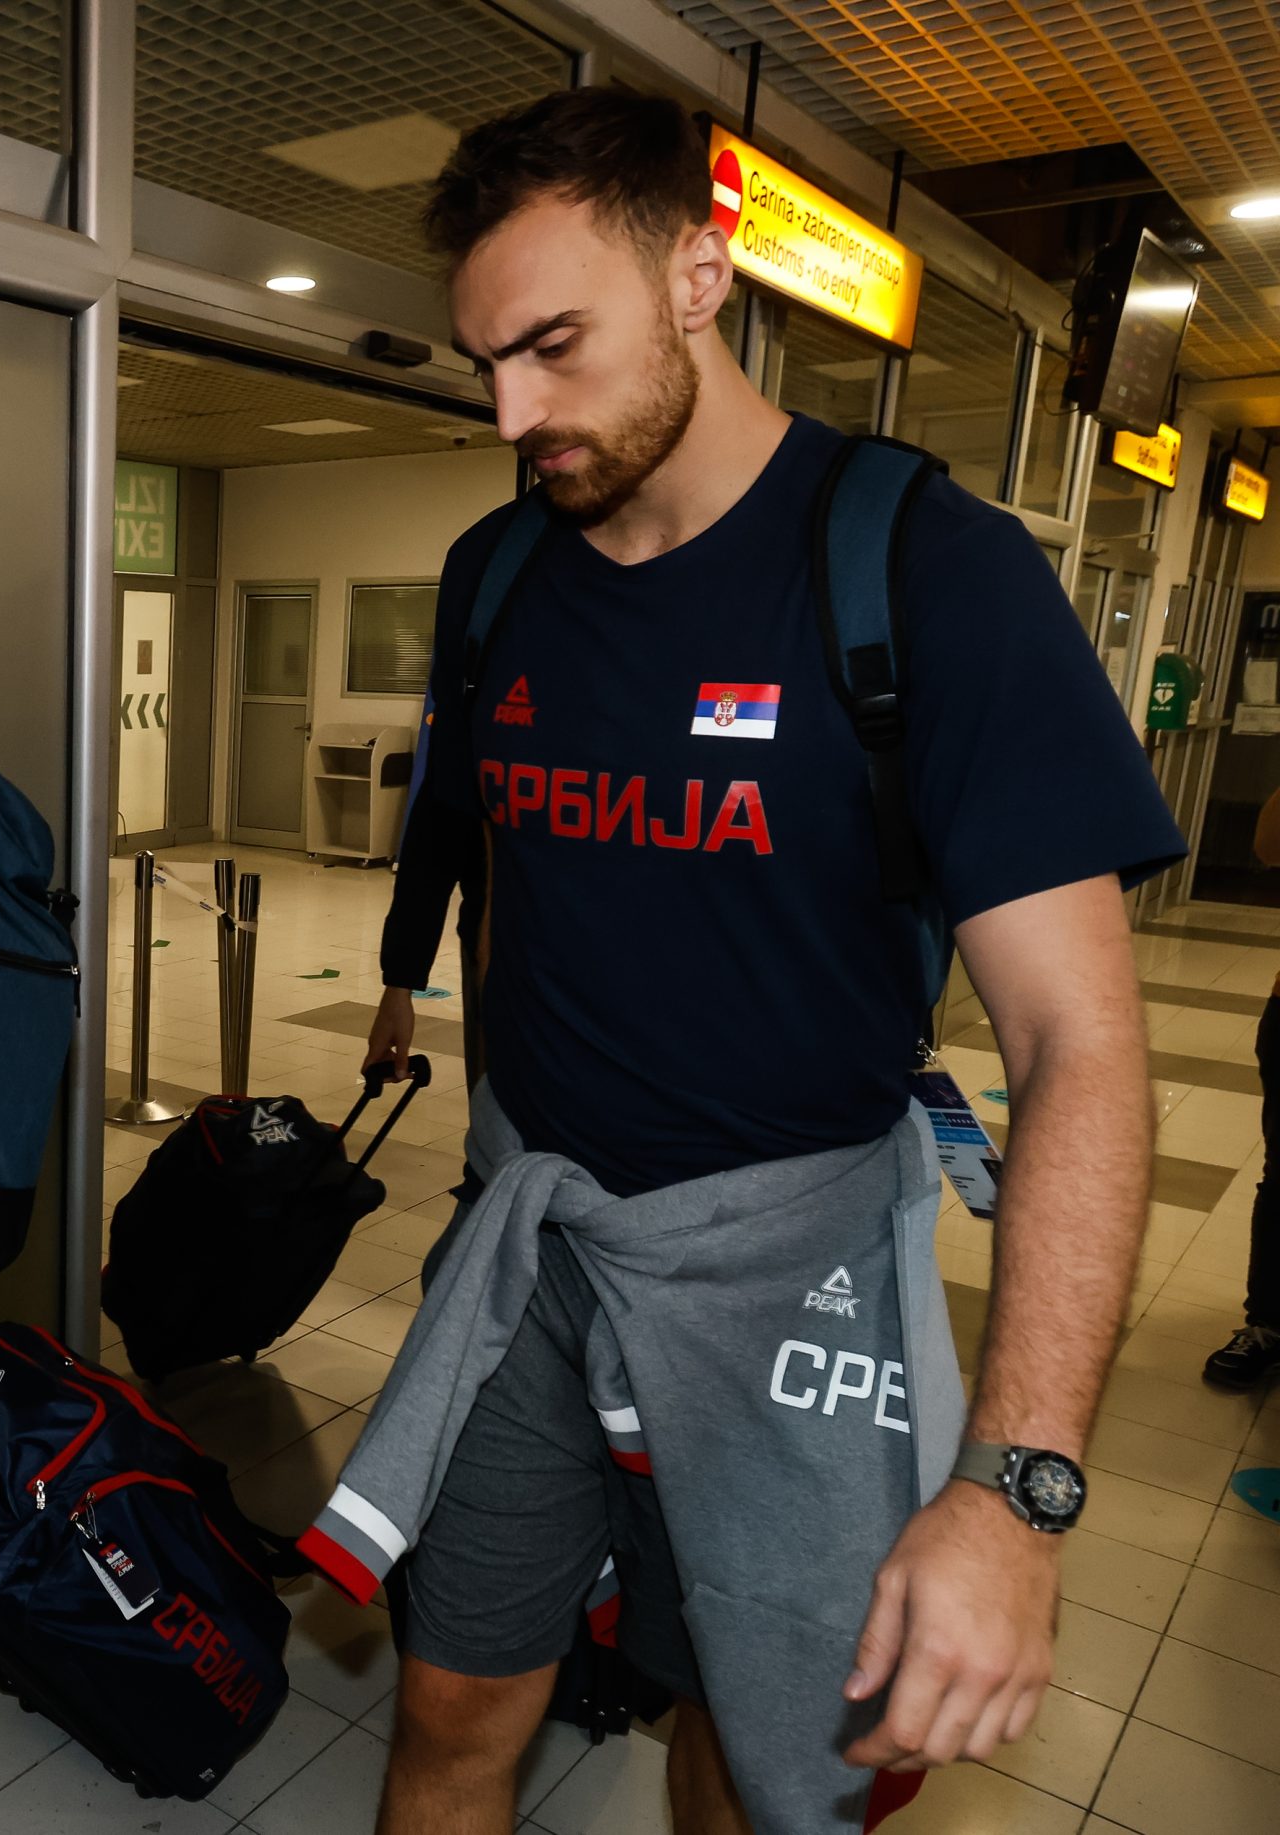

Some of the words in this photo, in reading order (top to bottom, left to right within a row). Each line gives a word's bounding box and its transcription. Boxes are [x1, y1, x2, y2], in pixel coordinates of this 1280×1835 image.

[743, 219, 805, 280] Customs
[812, 263, 827, 291] no
[831, 273, 862, 313] entry
[749, 171, 795, 224] Carina
[803, 211, 862, 264] zabranjen
[862, 246, 901, 291] pristup
[480, 758, 773, 856] СРБИЈА
[803, 1289, 861, 1319] PEAK
[152, 1592, 264, 1726] СРБИЈА
